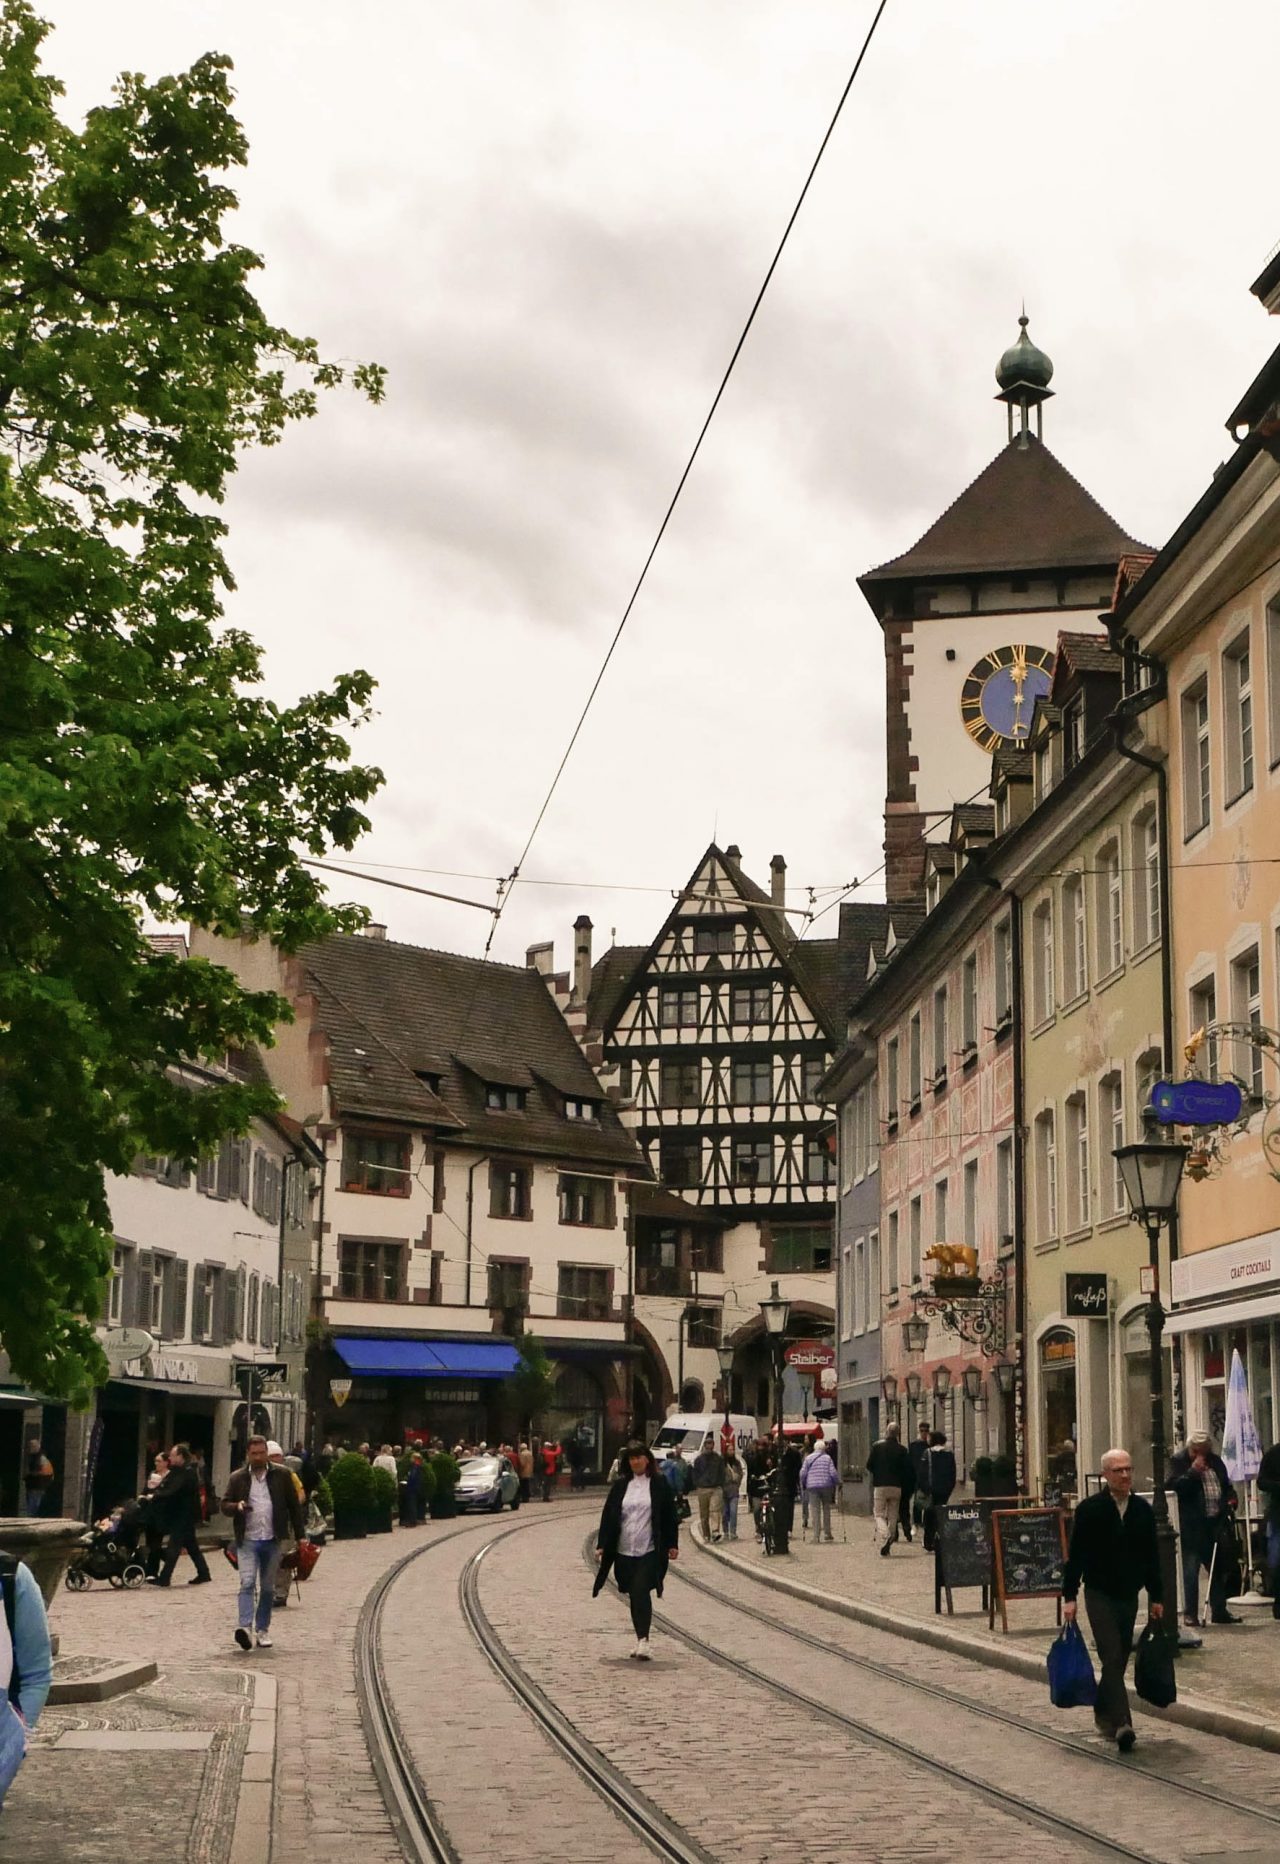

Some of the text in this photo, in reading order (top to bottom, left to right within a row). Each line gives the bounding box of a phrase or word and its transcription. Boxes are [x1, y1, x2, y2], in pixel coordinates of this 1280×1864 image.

[1230, 1259, 1271, 1280] CRAFT COCKTAILS
[789, 1352, 833, 1365] Steiber
